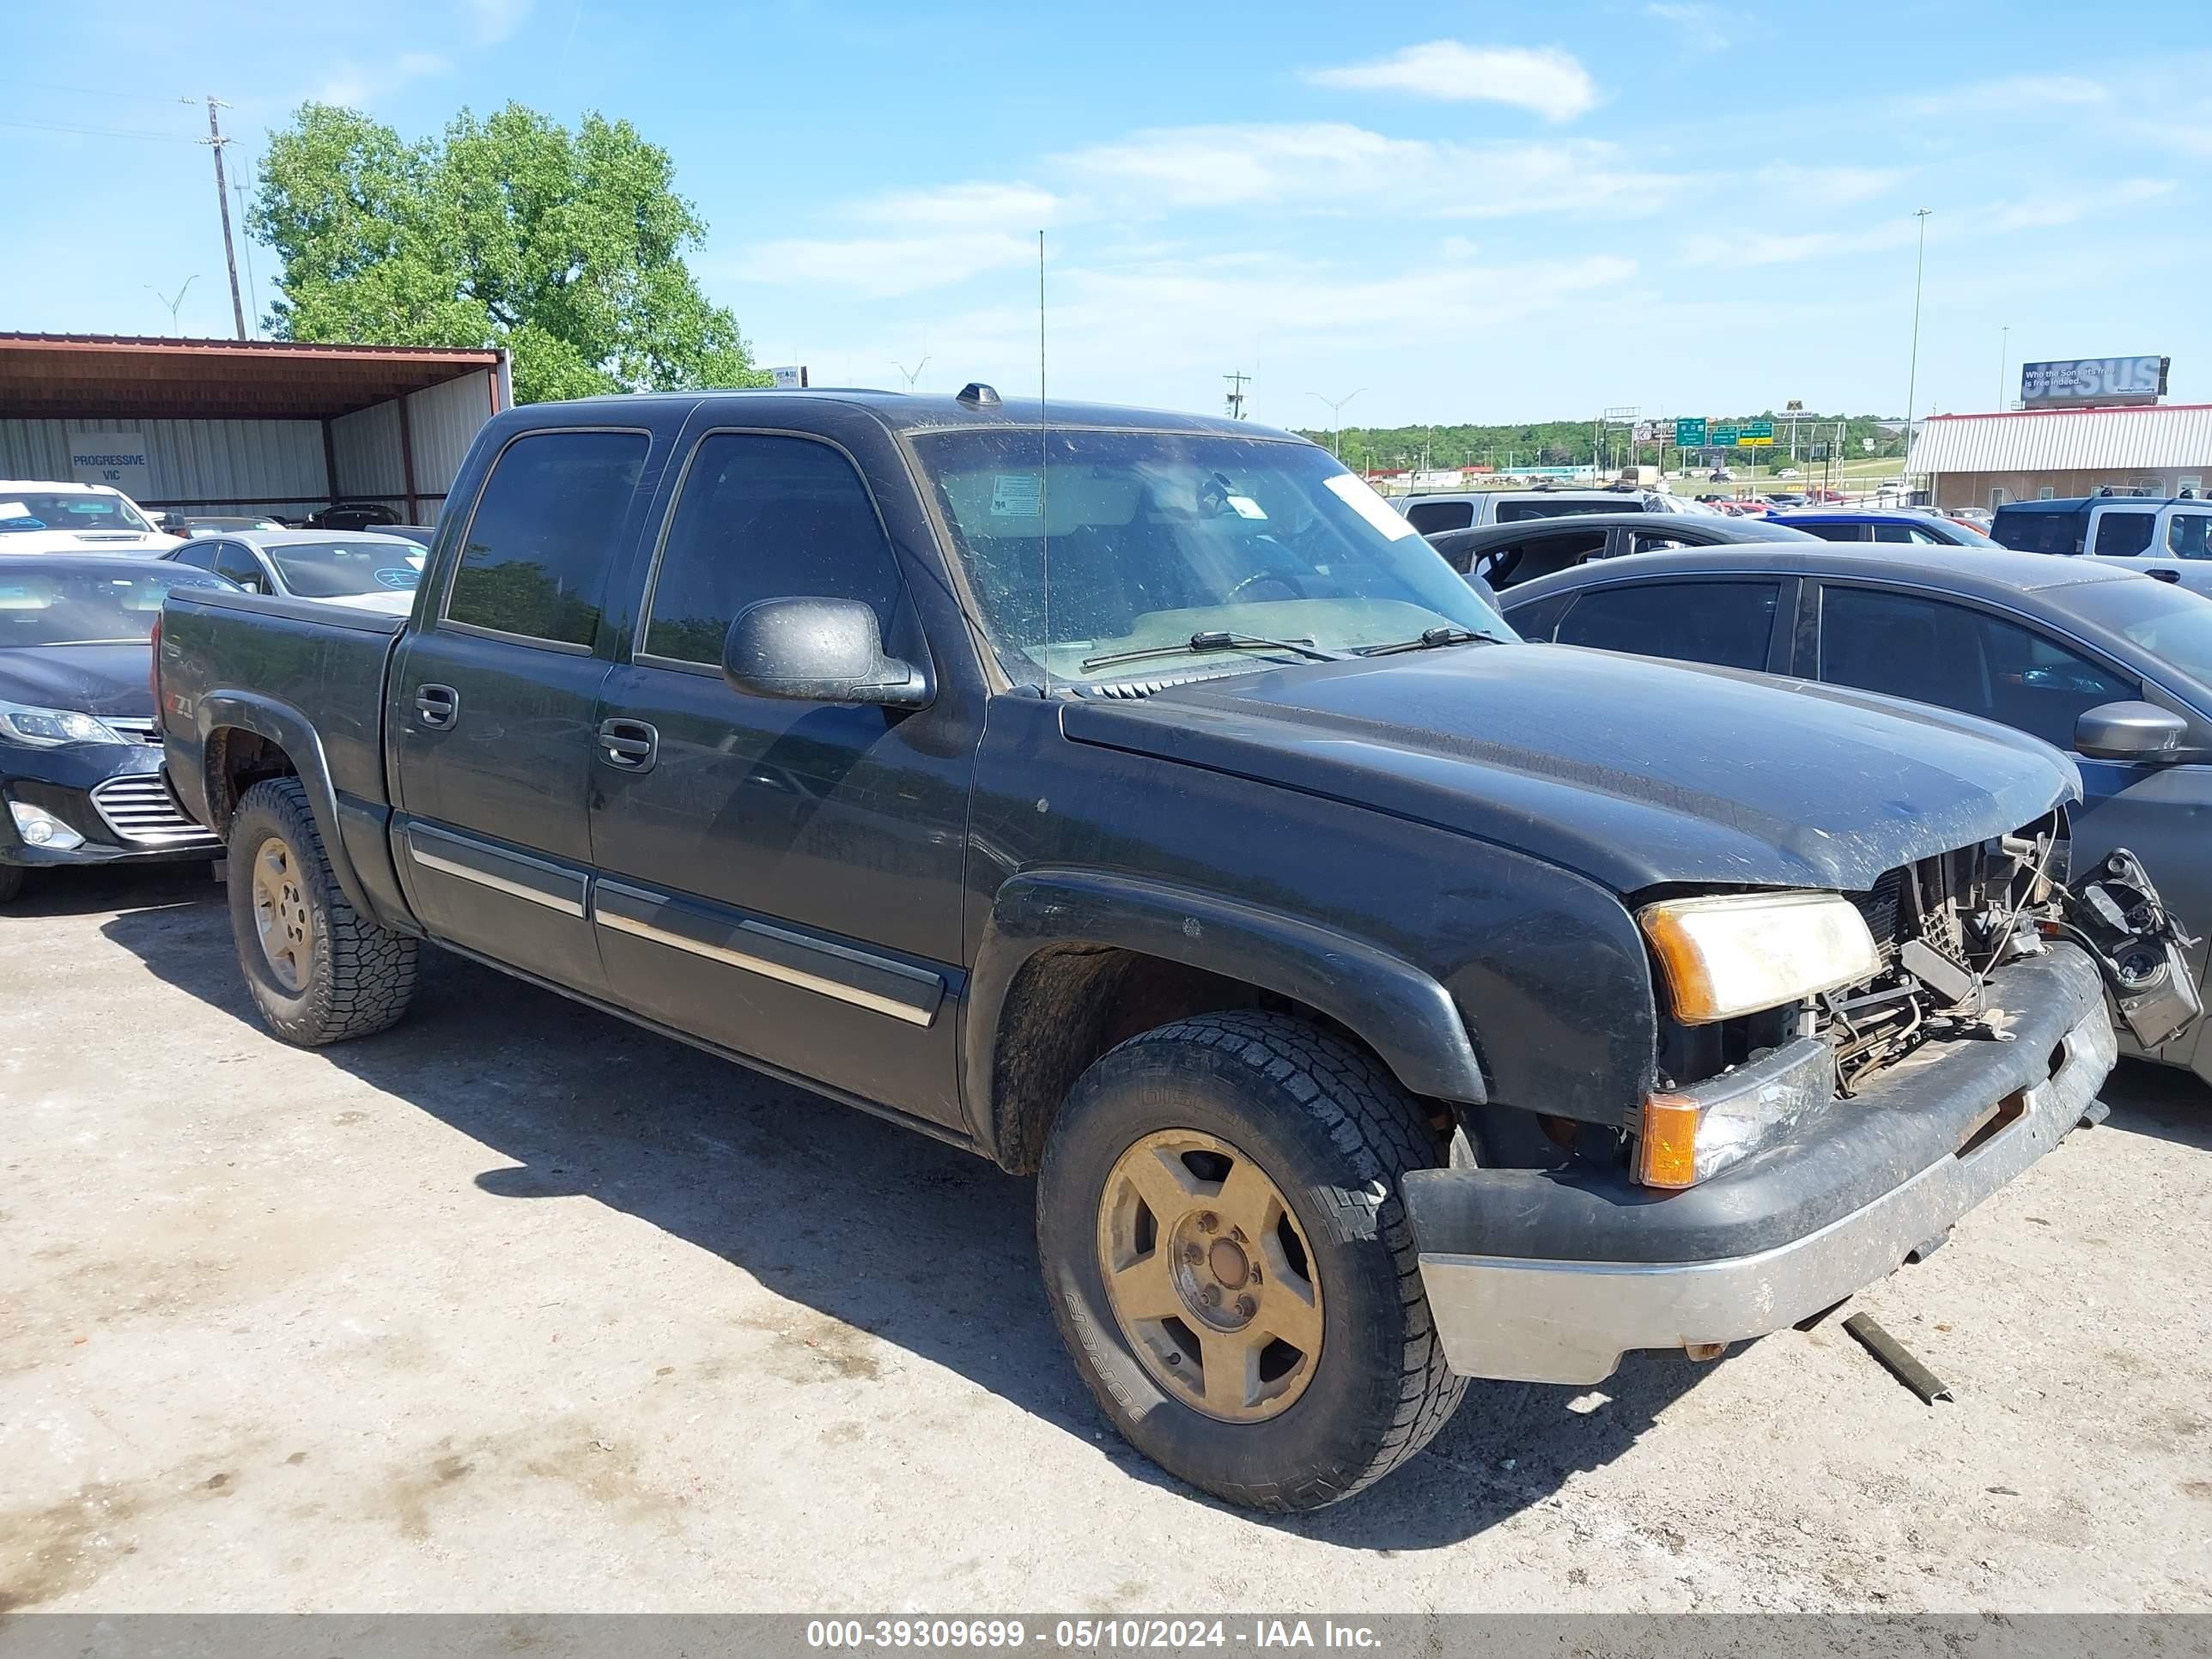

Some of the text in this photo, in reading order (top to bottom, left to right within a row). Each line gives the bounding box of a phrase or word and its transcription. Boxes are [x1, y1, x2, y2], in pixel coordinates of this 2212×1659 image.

[2022, 357, 2160, 398] JESUS
[2026, 370, 2044, 379] Who
[2061, 369, 2075, 378] Son
[73, 455, 145, 465] PROGRESSIVE
[103, 469, 120, 481] VIC
